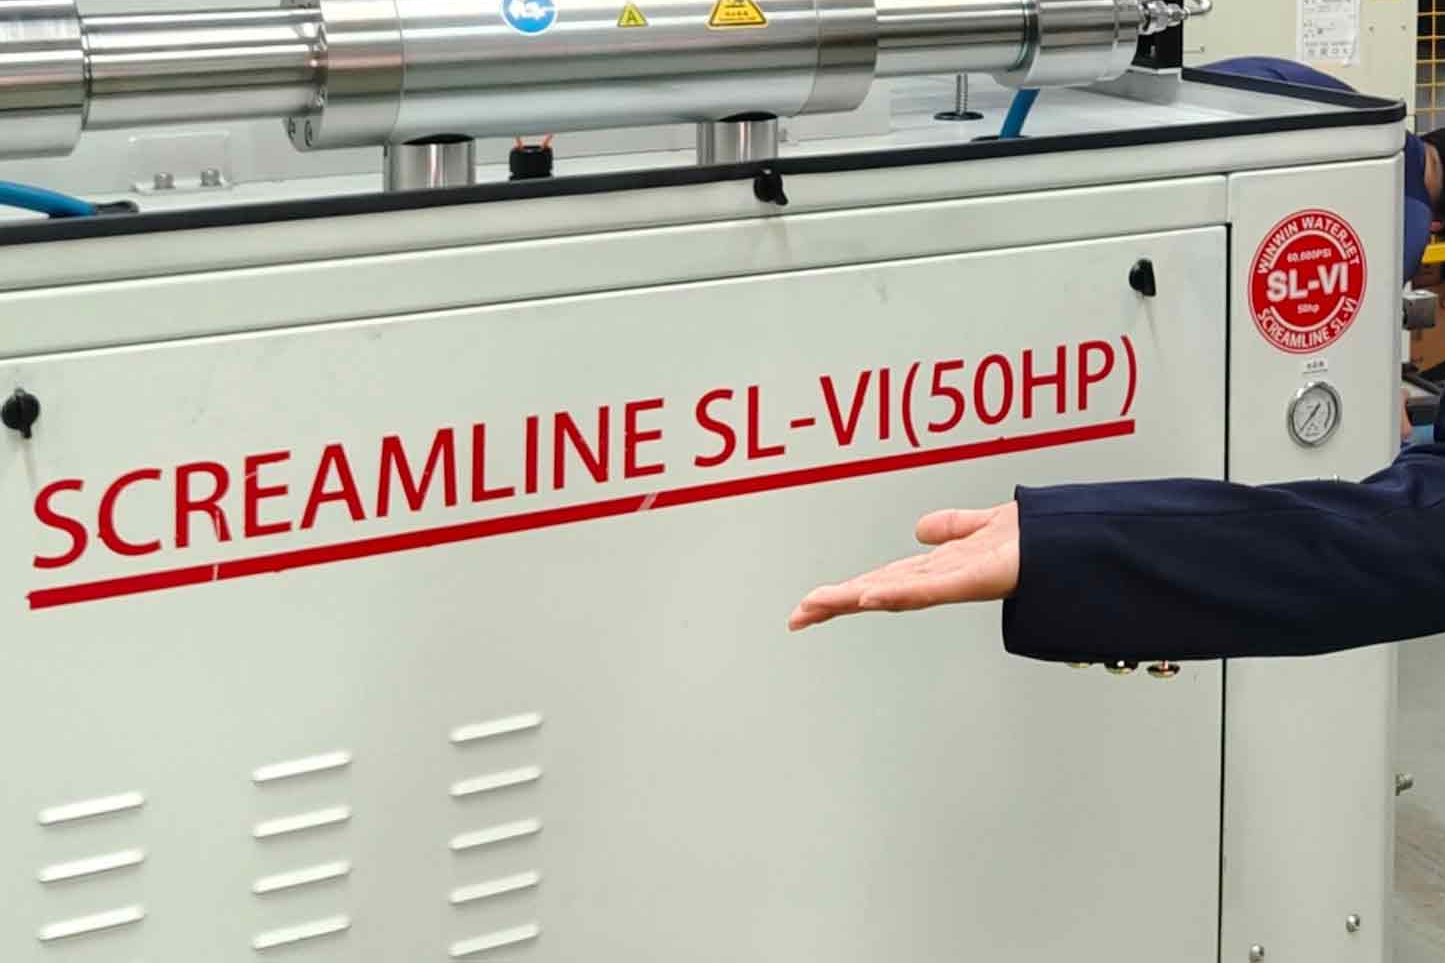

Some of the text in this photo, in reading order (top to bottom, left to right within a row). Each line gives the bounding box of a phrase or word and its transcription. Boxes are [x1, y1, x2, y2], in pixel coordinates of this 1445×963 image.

[1256, 216, 1361, 275] WINWIN WATERJET
[1266, 262, 1349, 302] SL-VI
[1257, 297, 1359, 348] SCREAMLINE SL-VI
[32, 335, 1138, 569] SCREAMLINE SL-VI(50HP)
